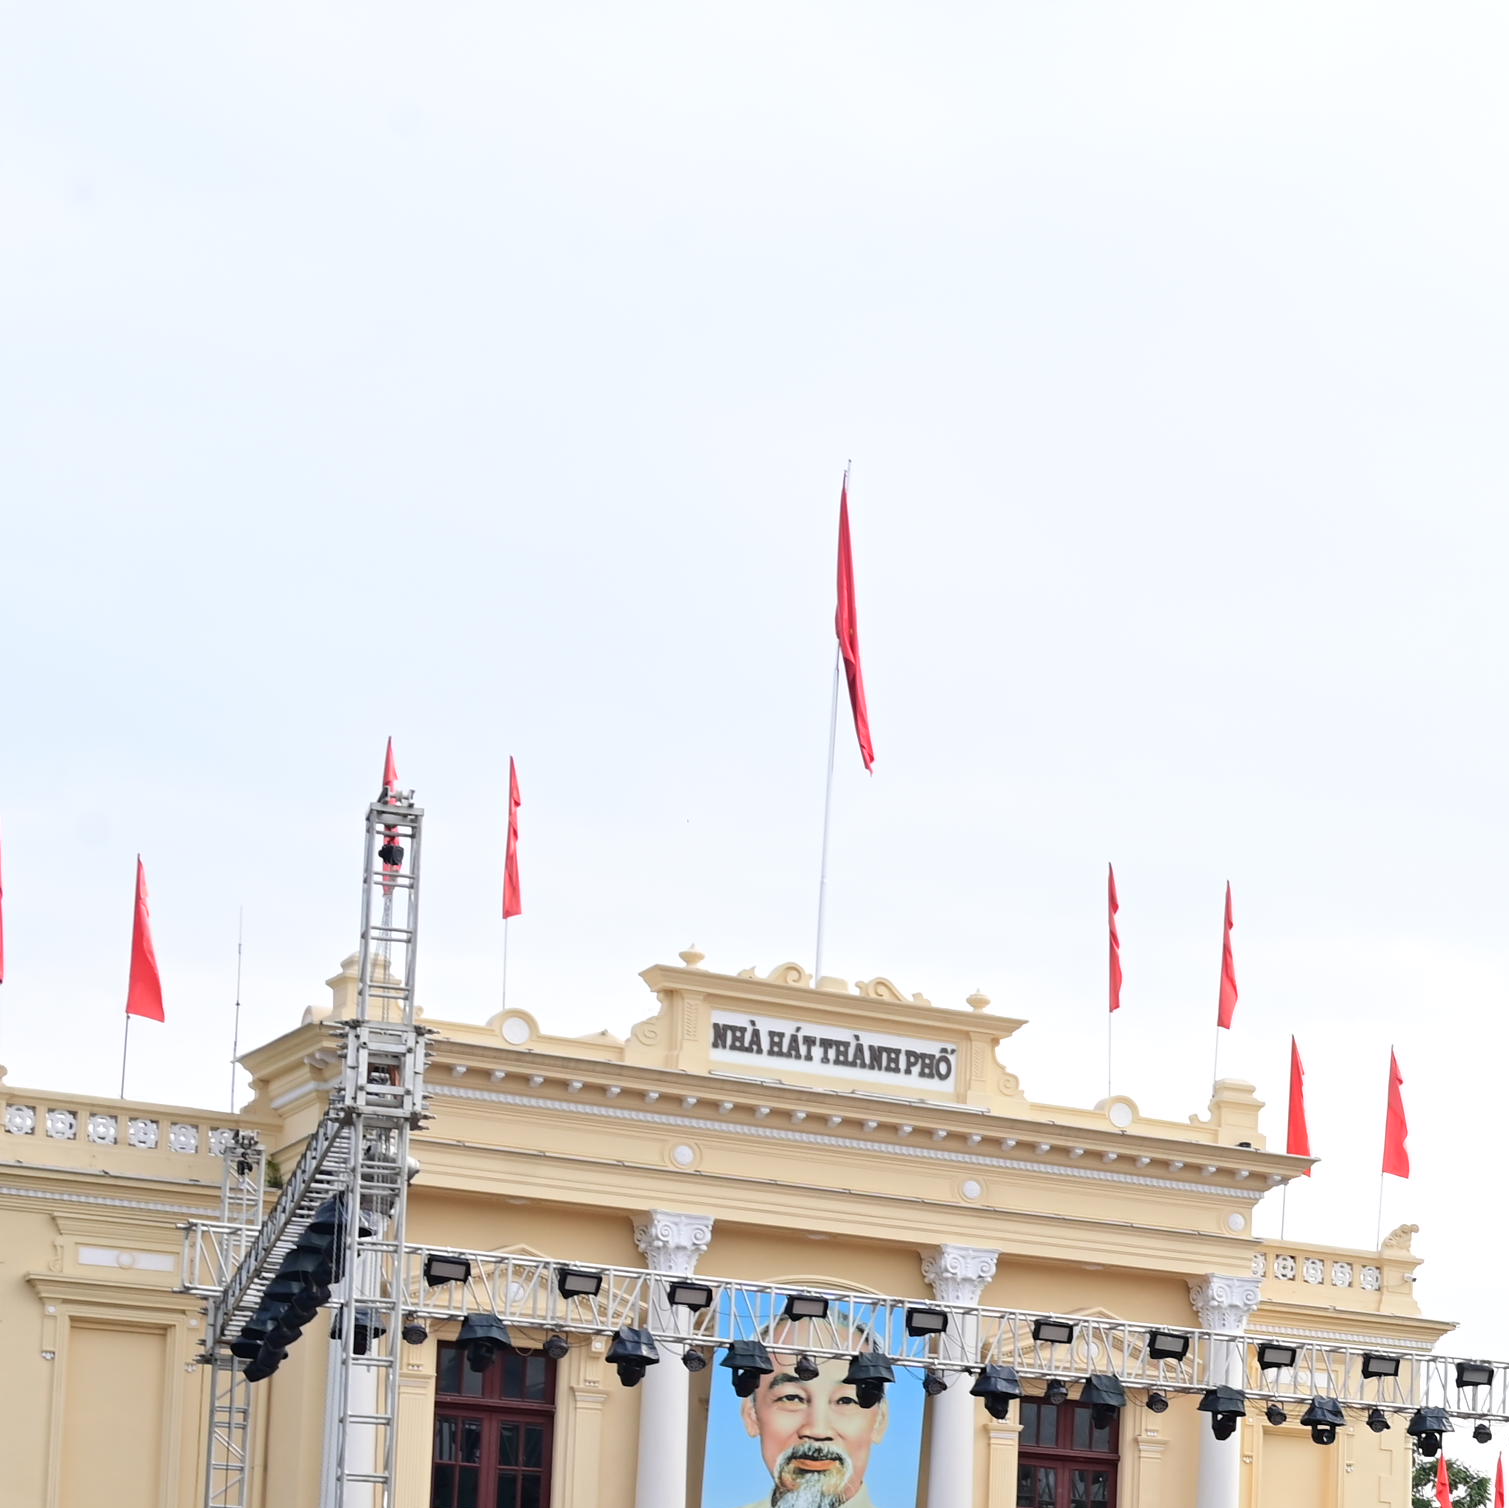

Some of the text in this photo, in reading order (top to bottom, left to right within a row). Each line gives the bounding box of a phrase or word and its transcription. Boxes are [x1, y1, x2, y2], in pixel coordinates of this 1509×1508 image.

[711, 1020, 957, 1081] NHÀ HÁT THÀNH PHỐ
